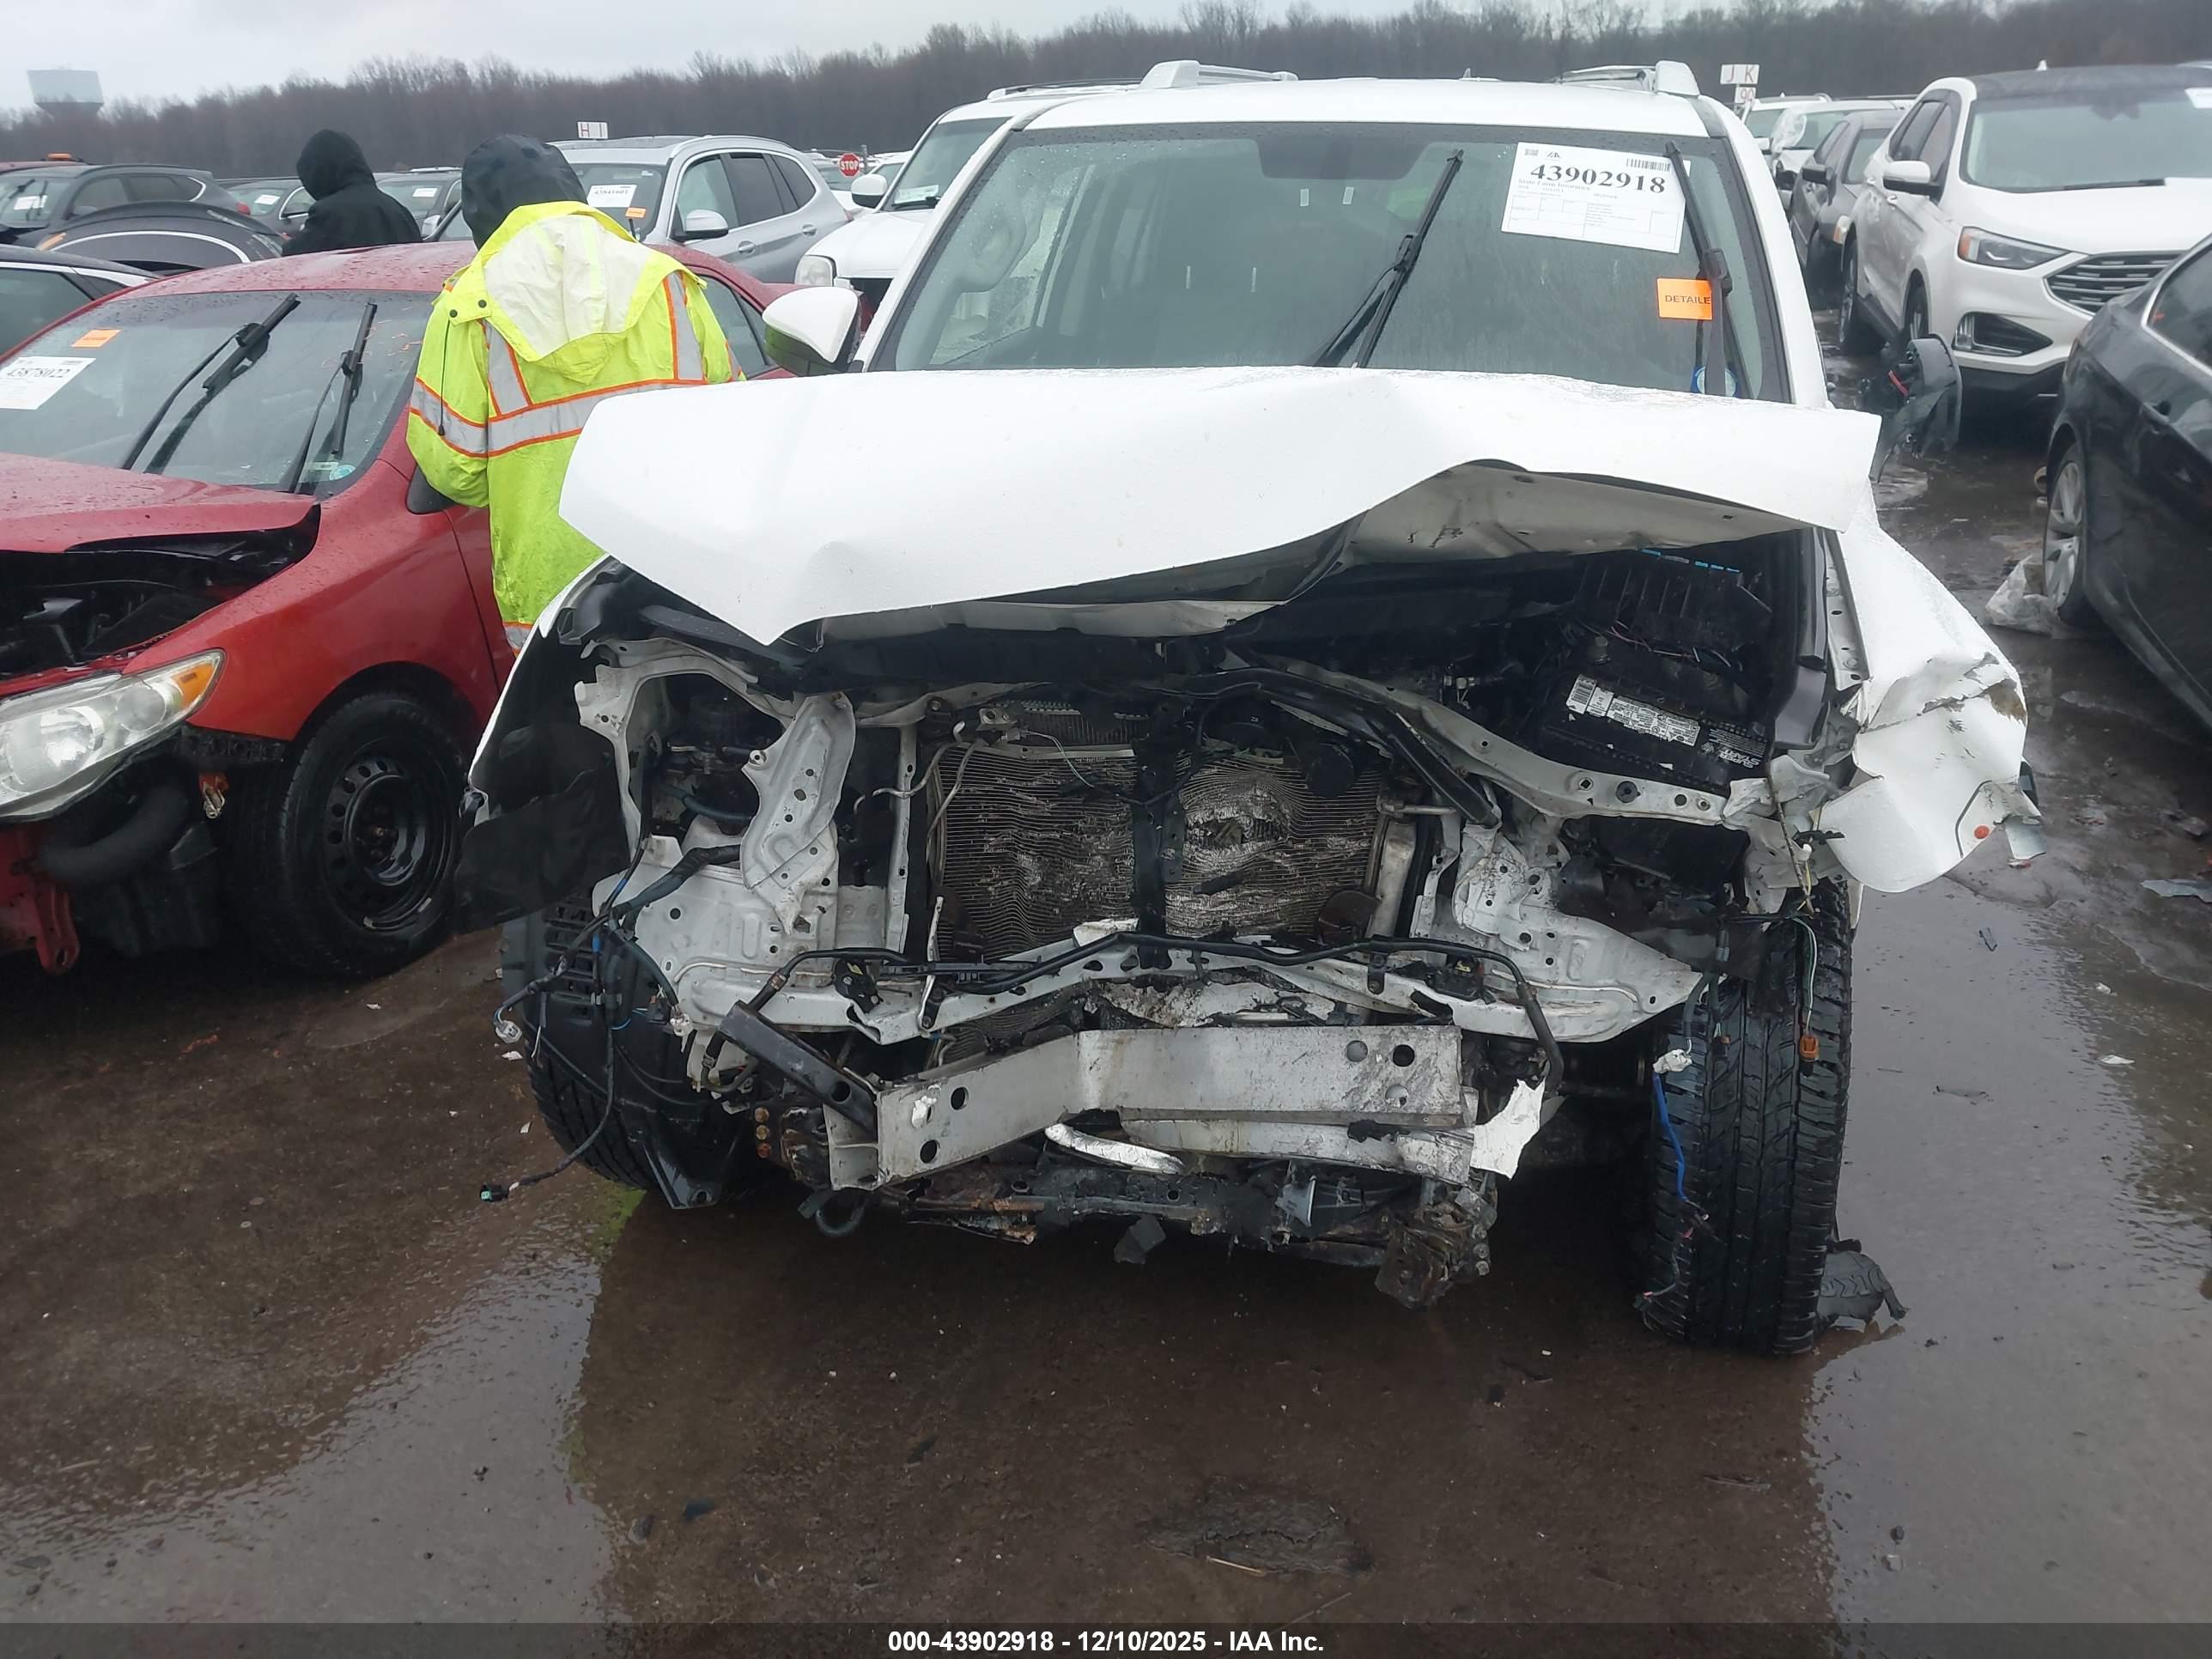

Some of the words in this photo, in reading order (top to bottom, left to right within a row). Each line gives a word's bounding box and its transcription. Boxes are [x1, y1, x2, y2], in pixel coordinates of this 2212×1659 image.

[1744, 65, 1755, 83] K
[580, 123, 590, 137] H
[841, 161, 859, 170] STOP
[1530, 164, 1666, 194] 43902918
[1664, 295, 1711, 305] DETAILE
